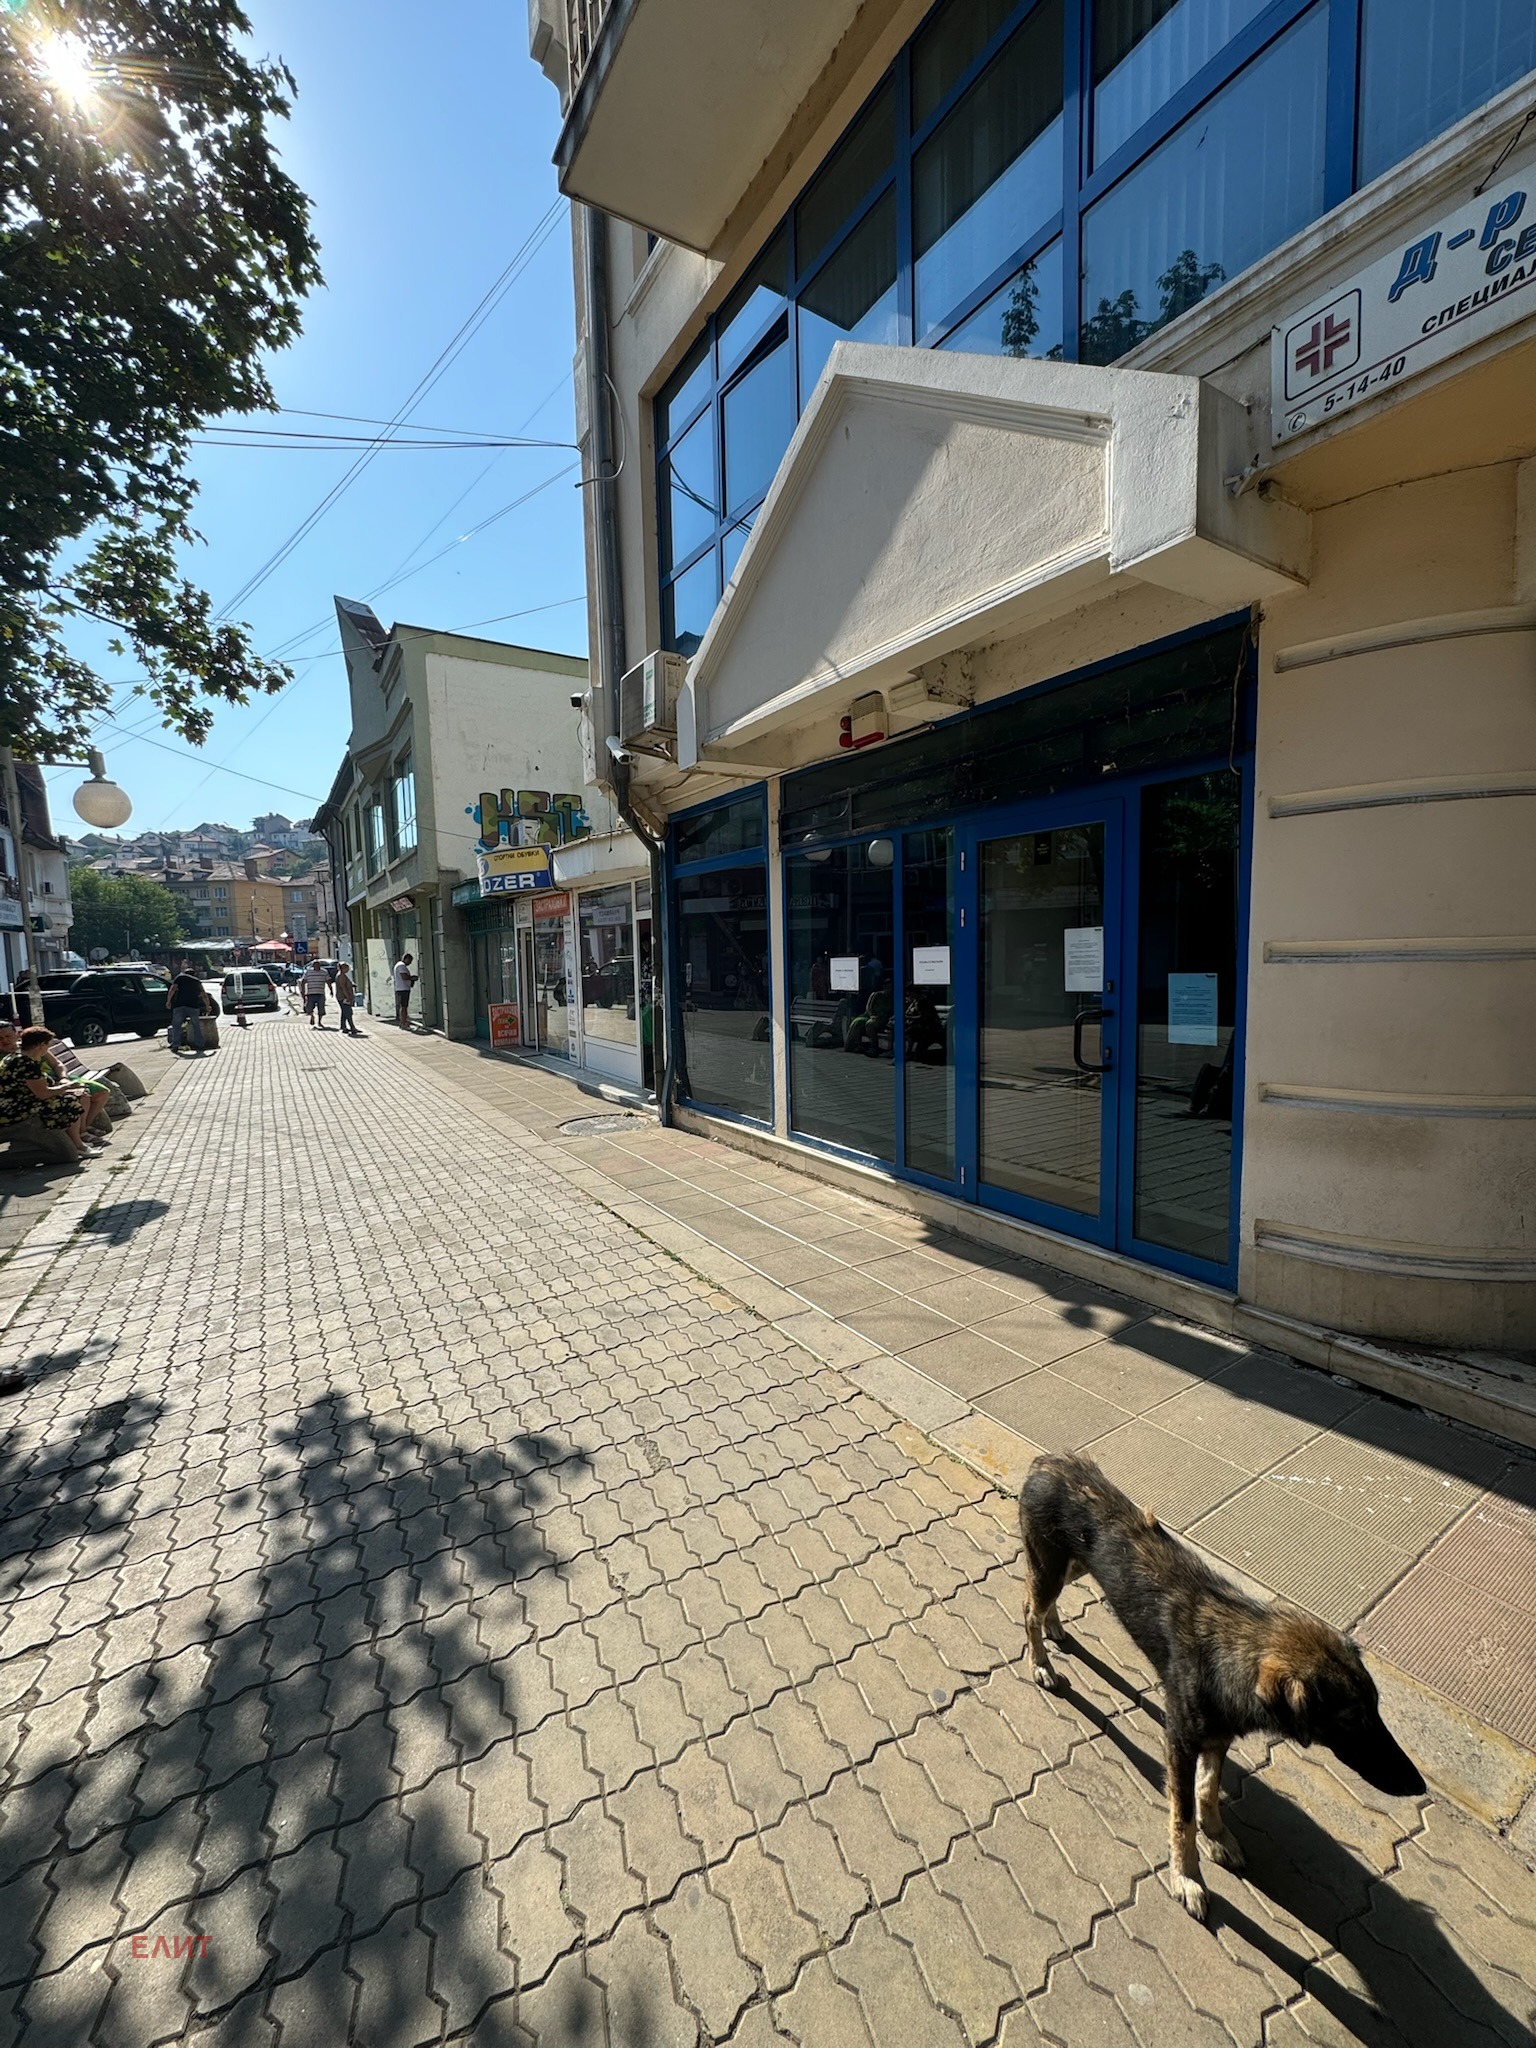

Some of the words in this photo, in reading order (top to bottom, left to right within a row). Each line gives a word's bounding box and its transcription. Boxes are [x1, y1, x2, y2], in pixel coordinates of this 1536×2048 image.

[1323, 356, 1406, 412] 5-14-40
[493, 852, 515, 861] СПОРТНИ
[516, 850, 540, 858] ОБУВКИ
